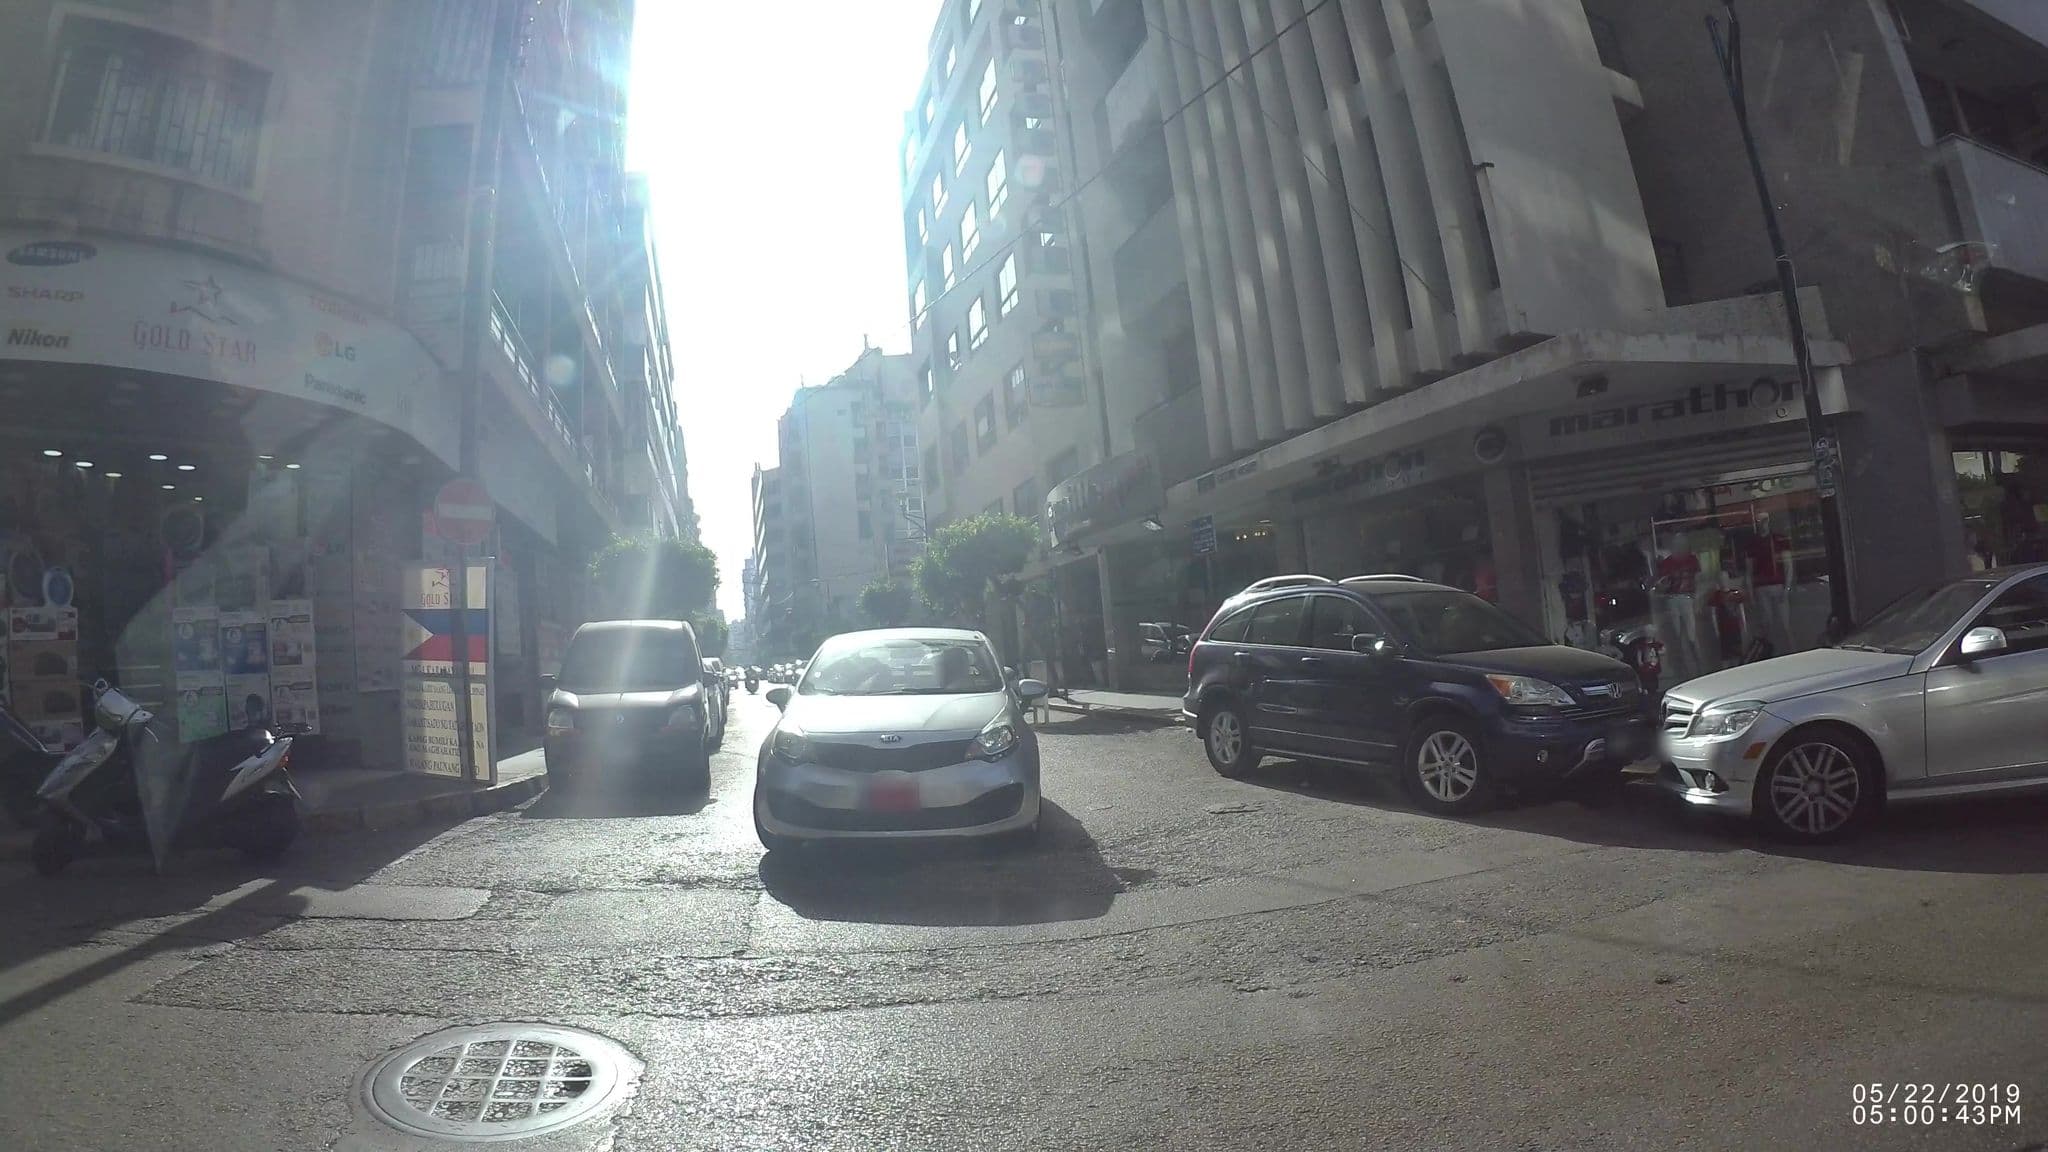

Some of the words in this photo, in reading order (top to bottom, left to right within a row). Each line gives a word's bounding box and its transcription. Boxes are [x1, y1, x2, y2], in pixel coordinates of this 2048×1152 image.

[8, 286, 86, 302] SHARP
[8, 328, 70, 348] Nikon
[134, 318, 191, 351] GOLD
[202, 333, 257, 365] STAR
[335, 341, 356, 361] LG
